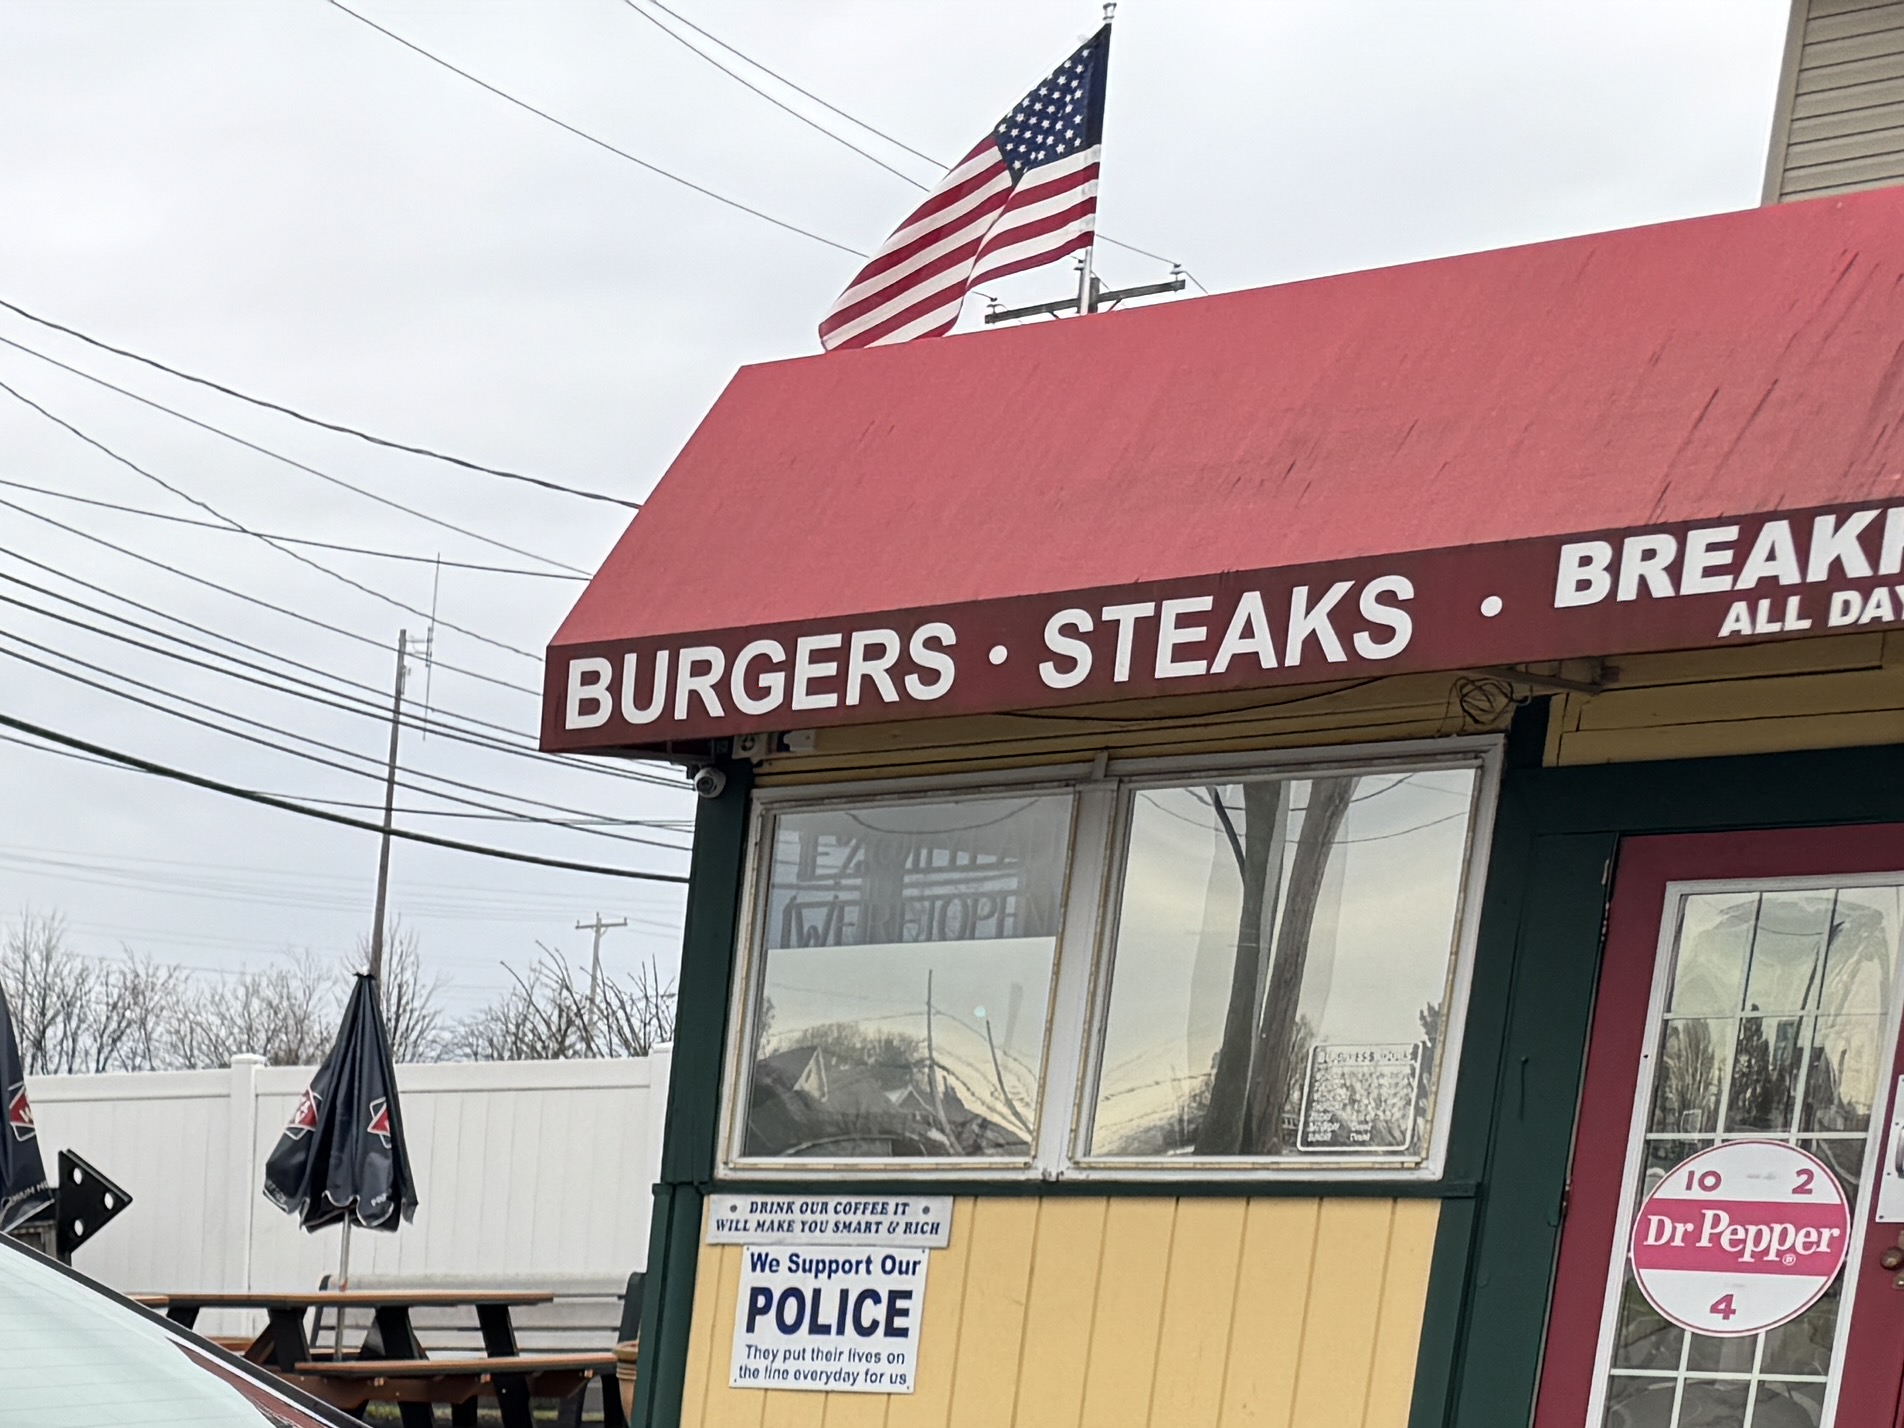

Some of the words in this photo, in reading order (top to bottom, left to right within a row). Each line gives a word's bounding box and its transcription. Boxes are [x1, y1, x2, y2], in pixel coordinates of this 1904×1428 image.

[1717, 595, 1813, 638] ALL
[565, 622, 957, 730] BURGERS
[1038, 574, 1415, 690] STEAKS
[1685, 1170, 1722, 1192] 10
[1792, 1168, 1815, 1195] 2
[749, 1201, 794, 1215] DRINK
[799, 1201, 828, 1215] OUR
[833, 1201, 889, 1216] COFFEE
[893, 1203, 910, 1216] IT
[716, 1219, 750, 1232] WILL
[754, 1220, 794, 1233] MAKE
[801, 1220, 827, 1234] YOU
[832, 1221, 882, 1234] SMART
[887, 1222, 899, 1235] &
[903, 1222, 940, 1235] RICH
[1643, 1215, 1694, 1247] Dr
[1695, 1209, 1840, 1262] Pepper
[750, 1252, 780, 1273] We
[787, 1253, 873, 1280] Support
[880, 1254, 921, 1276] Our
[745, 1286, 914, 1339] POLICE
[1709, 1293, 1736, 1320] 4
[745, 1344, 779, 1364] They
[782, 1346, 806, 1363] put
[810, 1346, 843, 1362] their
[848, 1348, 881, 1364] lives
[887, 1351, 905, 1364] on
[739, 1365, 759, 1380] the
[764, 1365, 789, 1381] line
[793, 1366, 860, 1387] everyday
[864, 1368, 884, 1384] for
[889, 1371, 907, 1386] us
